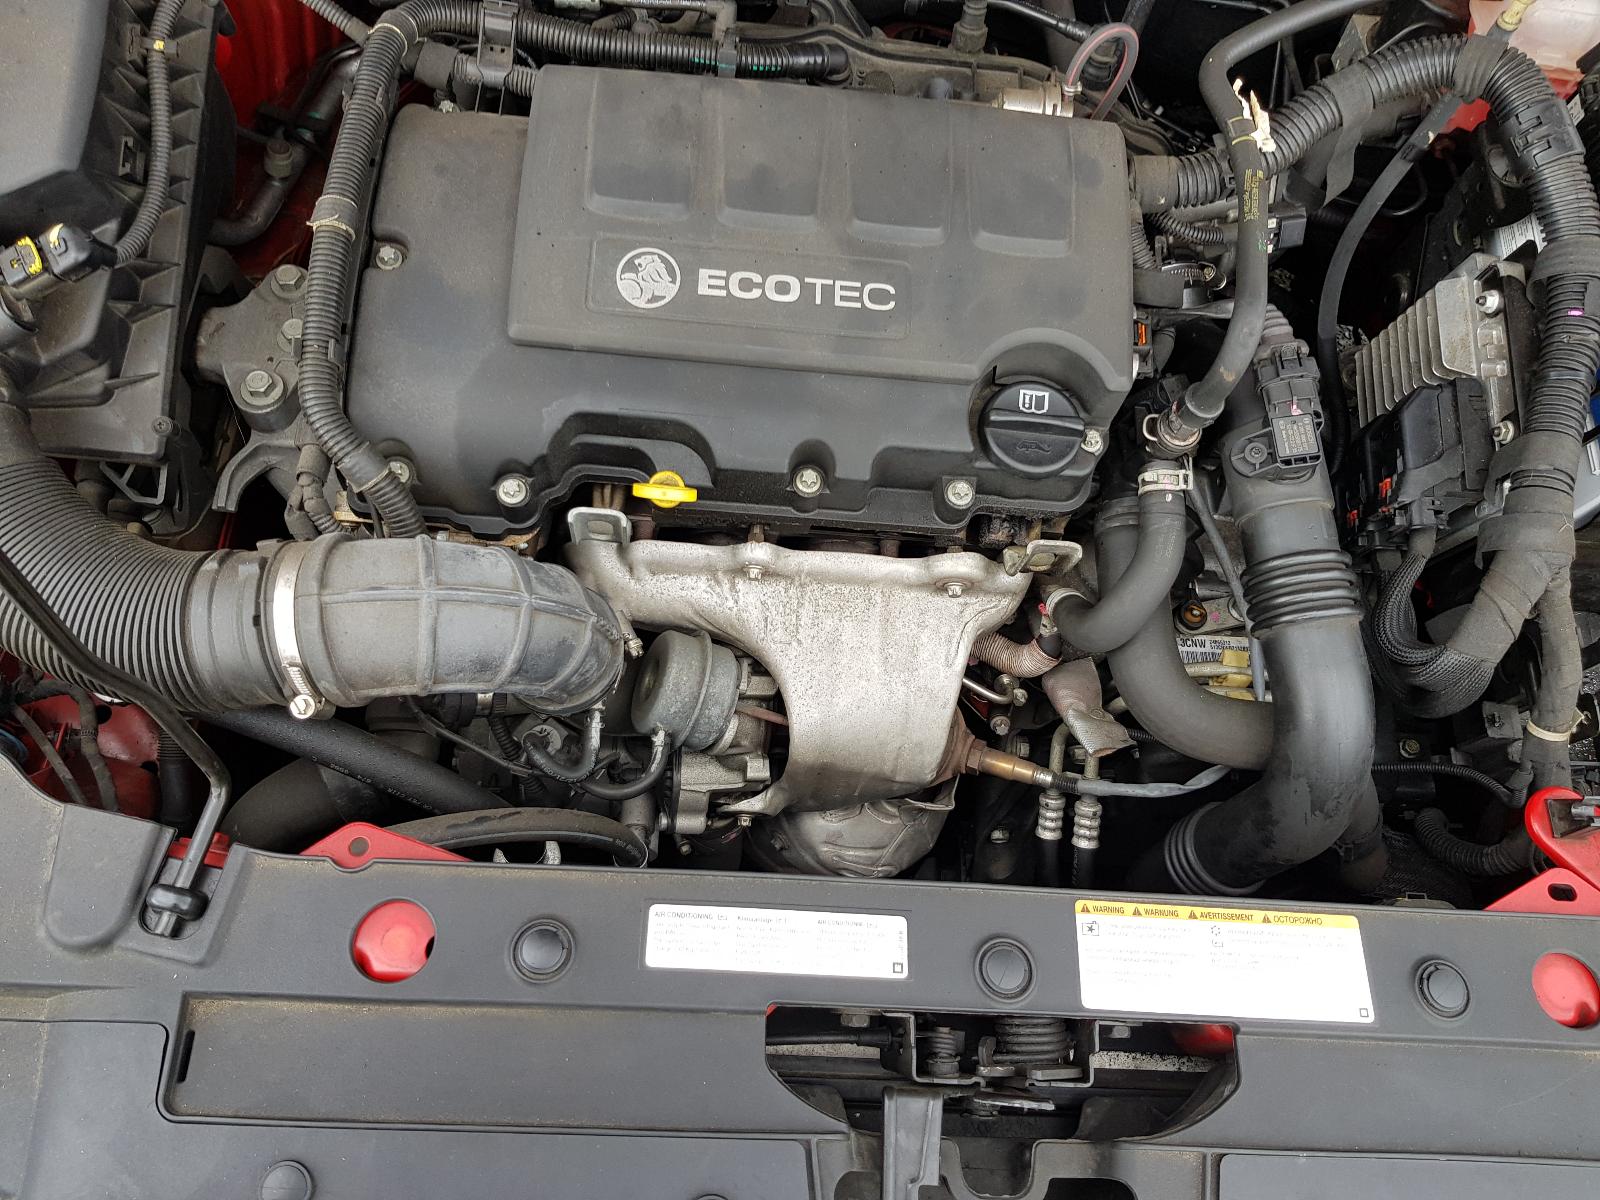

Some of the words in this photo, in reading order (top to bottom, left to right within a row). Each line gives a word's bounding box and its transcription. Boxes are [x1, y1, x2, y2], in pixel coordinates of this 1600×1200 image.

[698, 268, 896, 311] ECOTEC
[1180, 638, 1206, 648] 3CNW
[1092, 905, 1125, 914] WARNING
[1143, 908, 1179, 917] WARNUNG
[1199, 911, 1254, 921] AVERTISSEMENT
[1273, 915, 1323, 925] ОСТОРОЖНО
